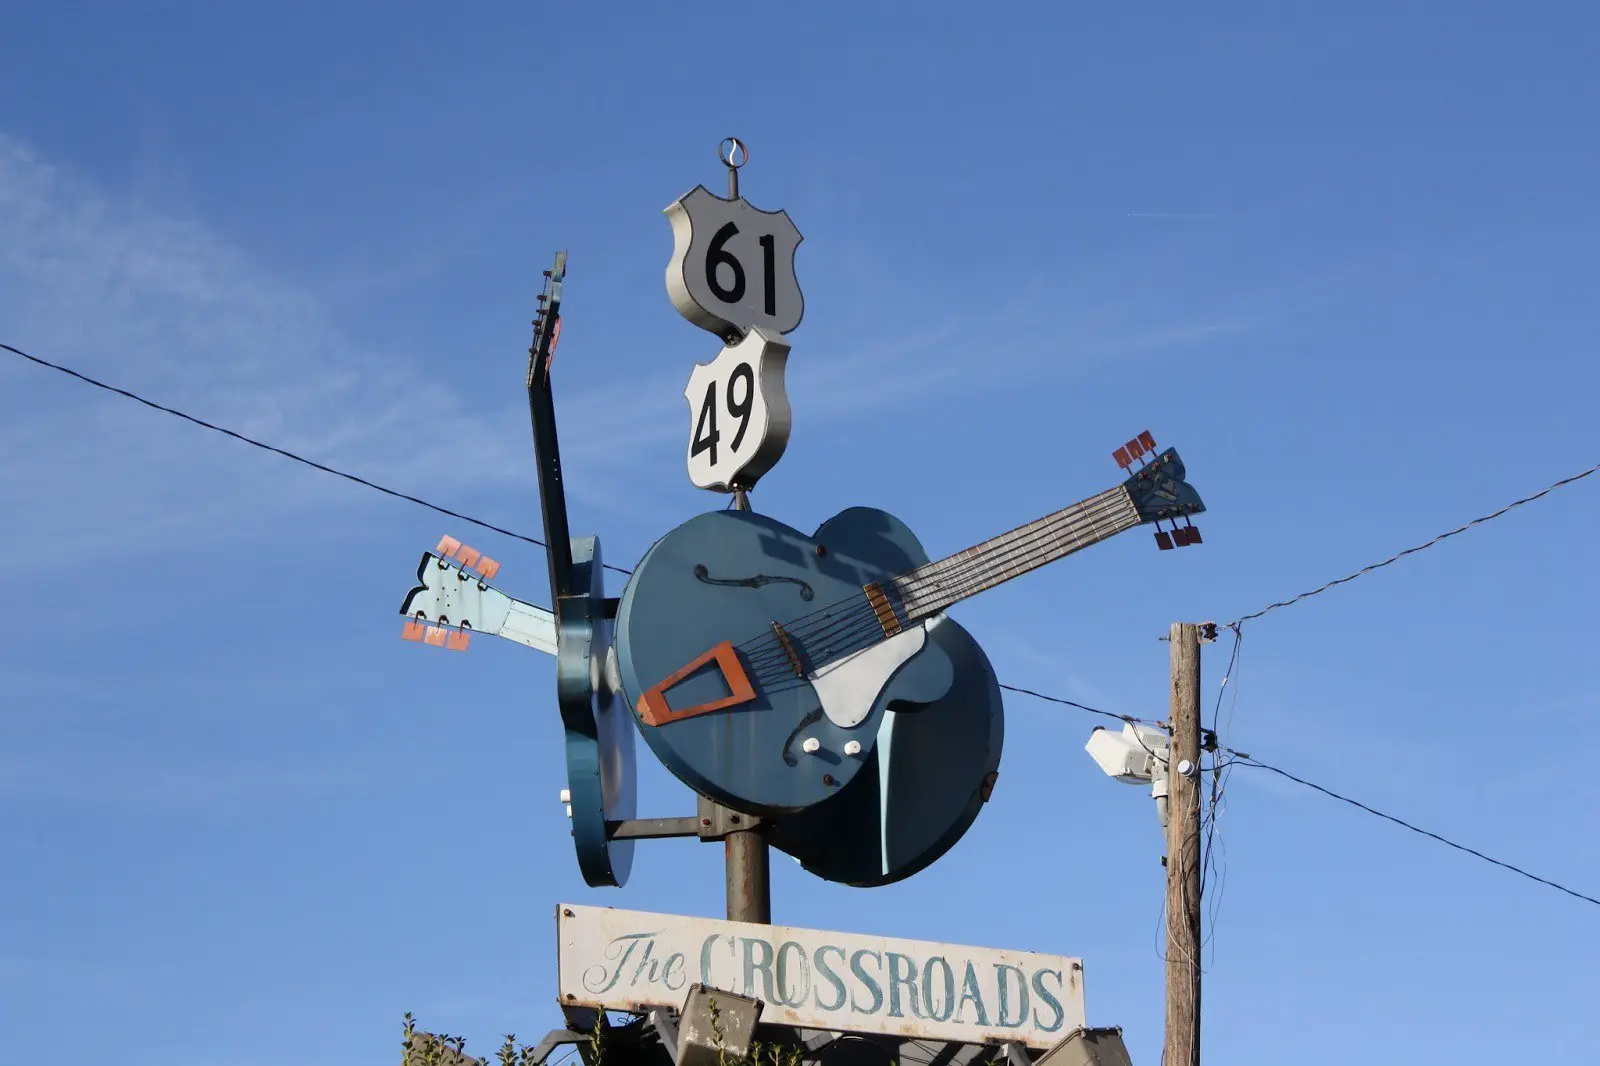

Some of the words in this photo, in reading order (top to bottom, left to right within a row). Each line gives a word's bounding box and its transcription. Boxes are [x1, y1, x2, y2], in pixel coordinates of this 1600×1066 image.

[705, 221, 776, 317] 61
[691, 362, 754, 467] 49
[582, 928, 687, 994] The
[699, 933, 1065, 1033] CROSSROADS
